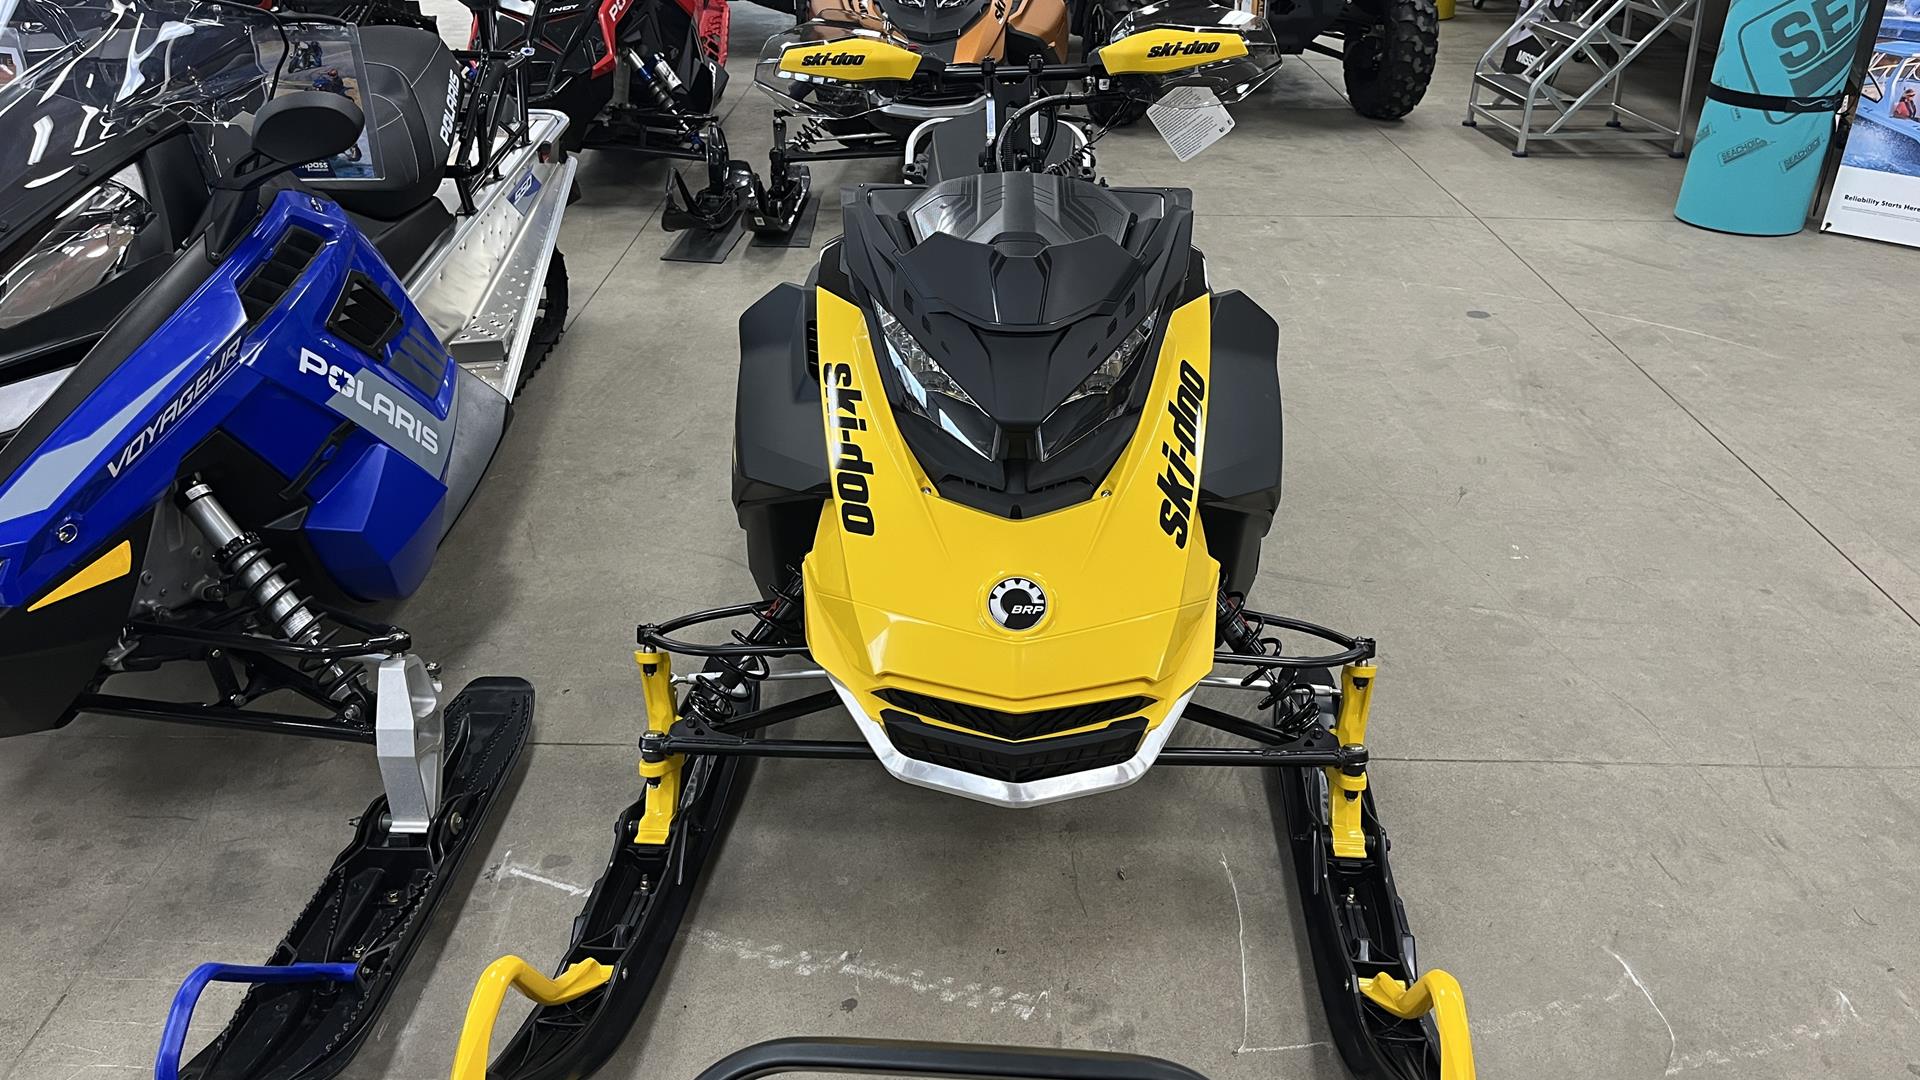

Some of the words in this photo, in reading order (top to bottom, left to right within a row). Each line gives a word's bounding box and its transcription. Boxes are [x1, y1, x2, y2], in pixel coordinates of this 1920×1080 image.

[549, 4, 579, 13] INDY
[801, 51, 866, 67] ski-doo
[1147, 40, 1221, 58] ski-doo
[439, 68, 460, 147] POLARIS
[1844, 194, 1880, 206] Reliability
[1880, 200, 1902, 209] Starts
[107, 335, 242, 478] VOYAGEUR
[299, 347, 439, 456] POLARIS
[823, 362, 875, 537] ski-doo
[1156, 359, 1206, 550] ski-doo
[1011, 604, 1045, 615] BRP
